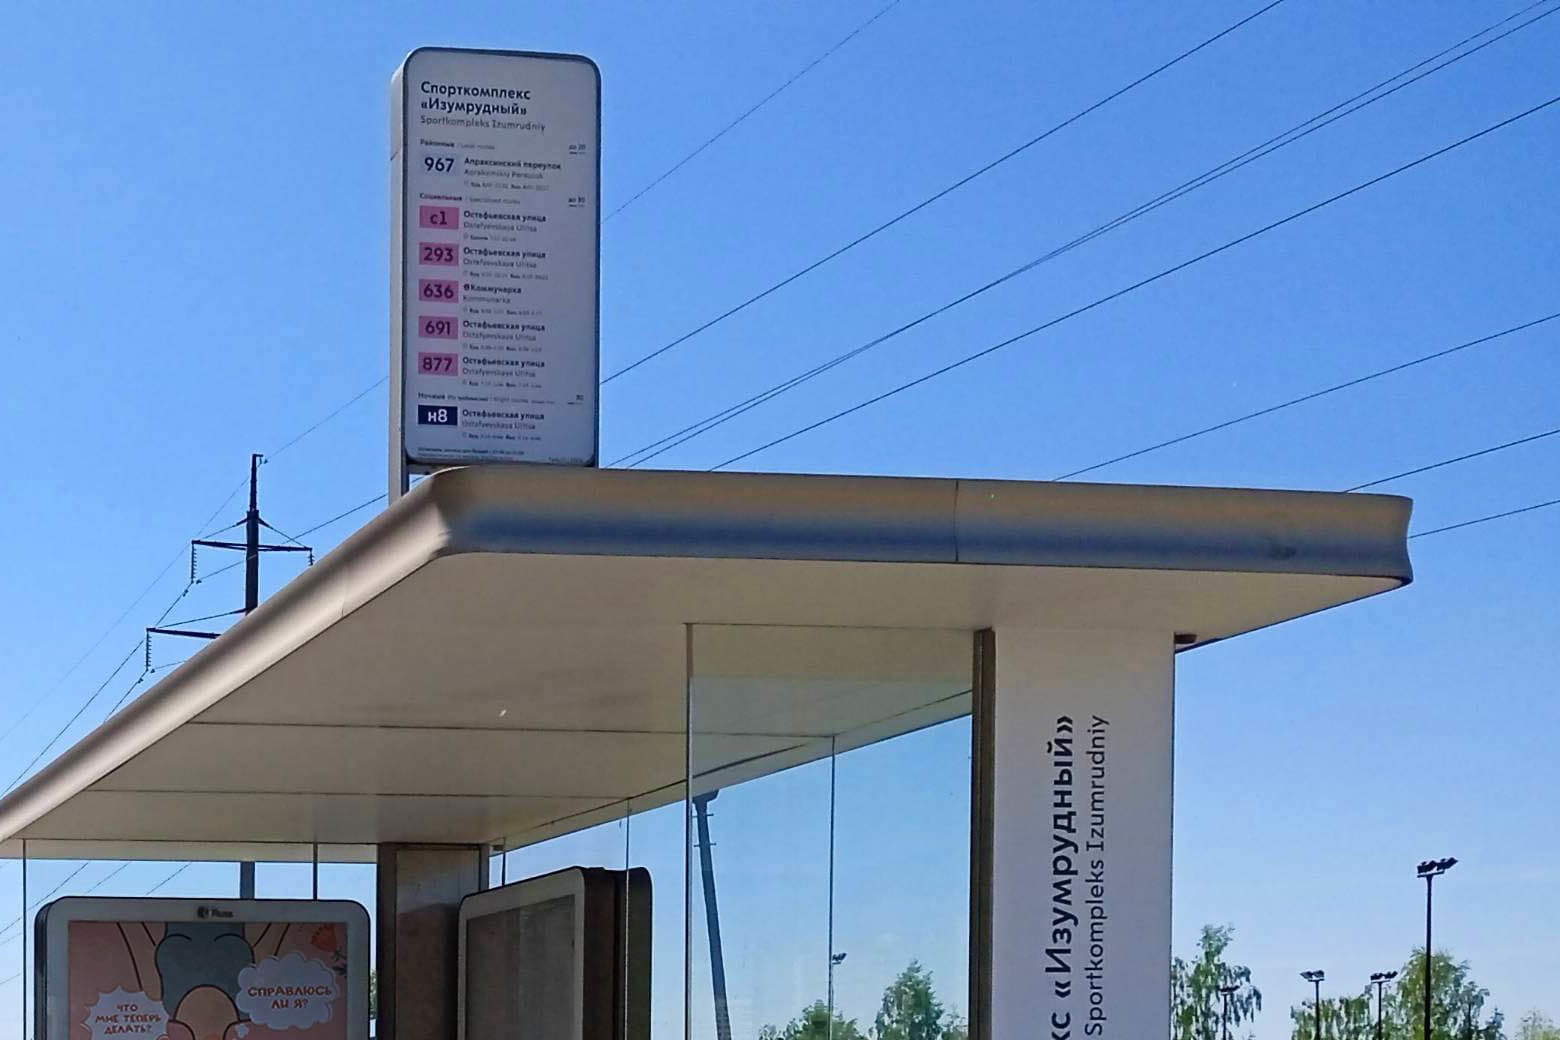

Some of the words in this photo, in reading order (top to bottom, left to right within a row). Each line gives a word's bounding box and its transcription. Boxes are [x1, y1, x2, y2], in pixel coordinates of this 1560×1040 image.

[420, 81, 532, 100] Спорткомплекс
[420, 97, 528, 116] «Изумрудный»
[420, 115, 490, 129] Sportkompleks
[491, 119, 546, 132] Izumrudniy
[424, 157, 455, 173] 967
[423, 247, 454, 263] 293
[423, 283, 454, 299] 636
[425, 320, 451, 336] 691
[422, 357, 453, 372] 877
[427, 408, 448, 423] н8
[1085, 714, 1111, 852] Izumrudniy
[1044, 715, 1080, 1000] «Изумрудный»
[1084, 859, 1110, 1037] Sportkompleks
[247, 985, 332, 997] СПРАВЛЮСЬ
[117, 1004, 138, 1013] ЧТО
[272, 999, 289, 1009] ЛИ
[294, 998, 309, 1009] Я?
[95, 1014, 119, 1024] МНЕ
[123, 1014, 162, 1023] ТЕПЕРЬ
[104, 1024, 152, 1035] ДЕЛАТЬ?
